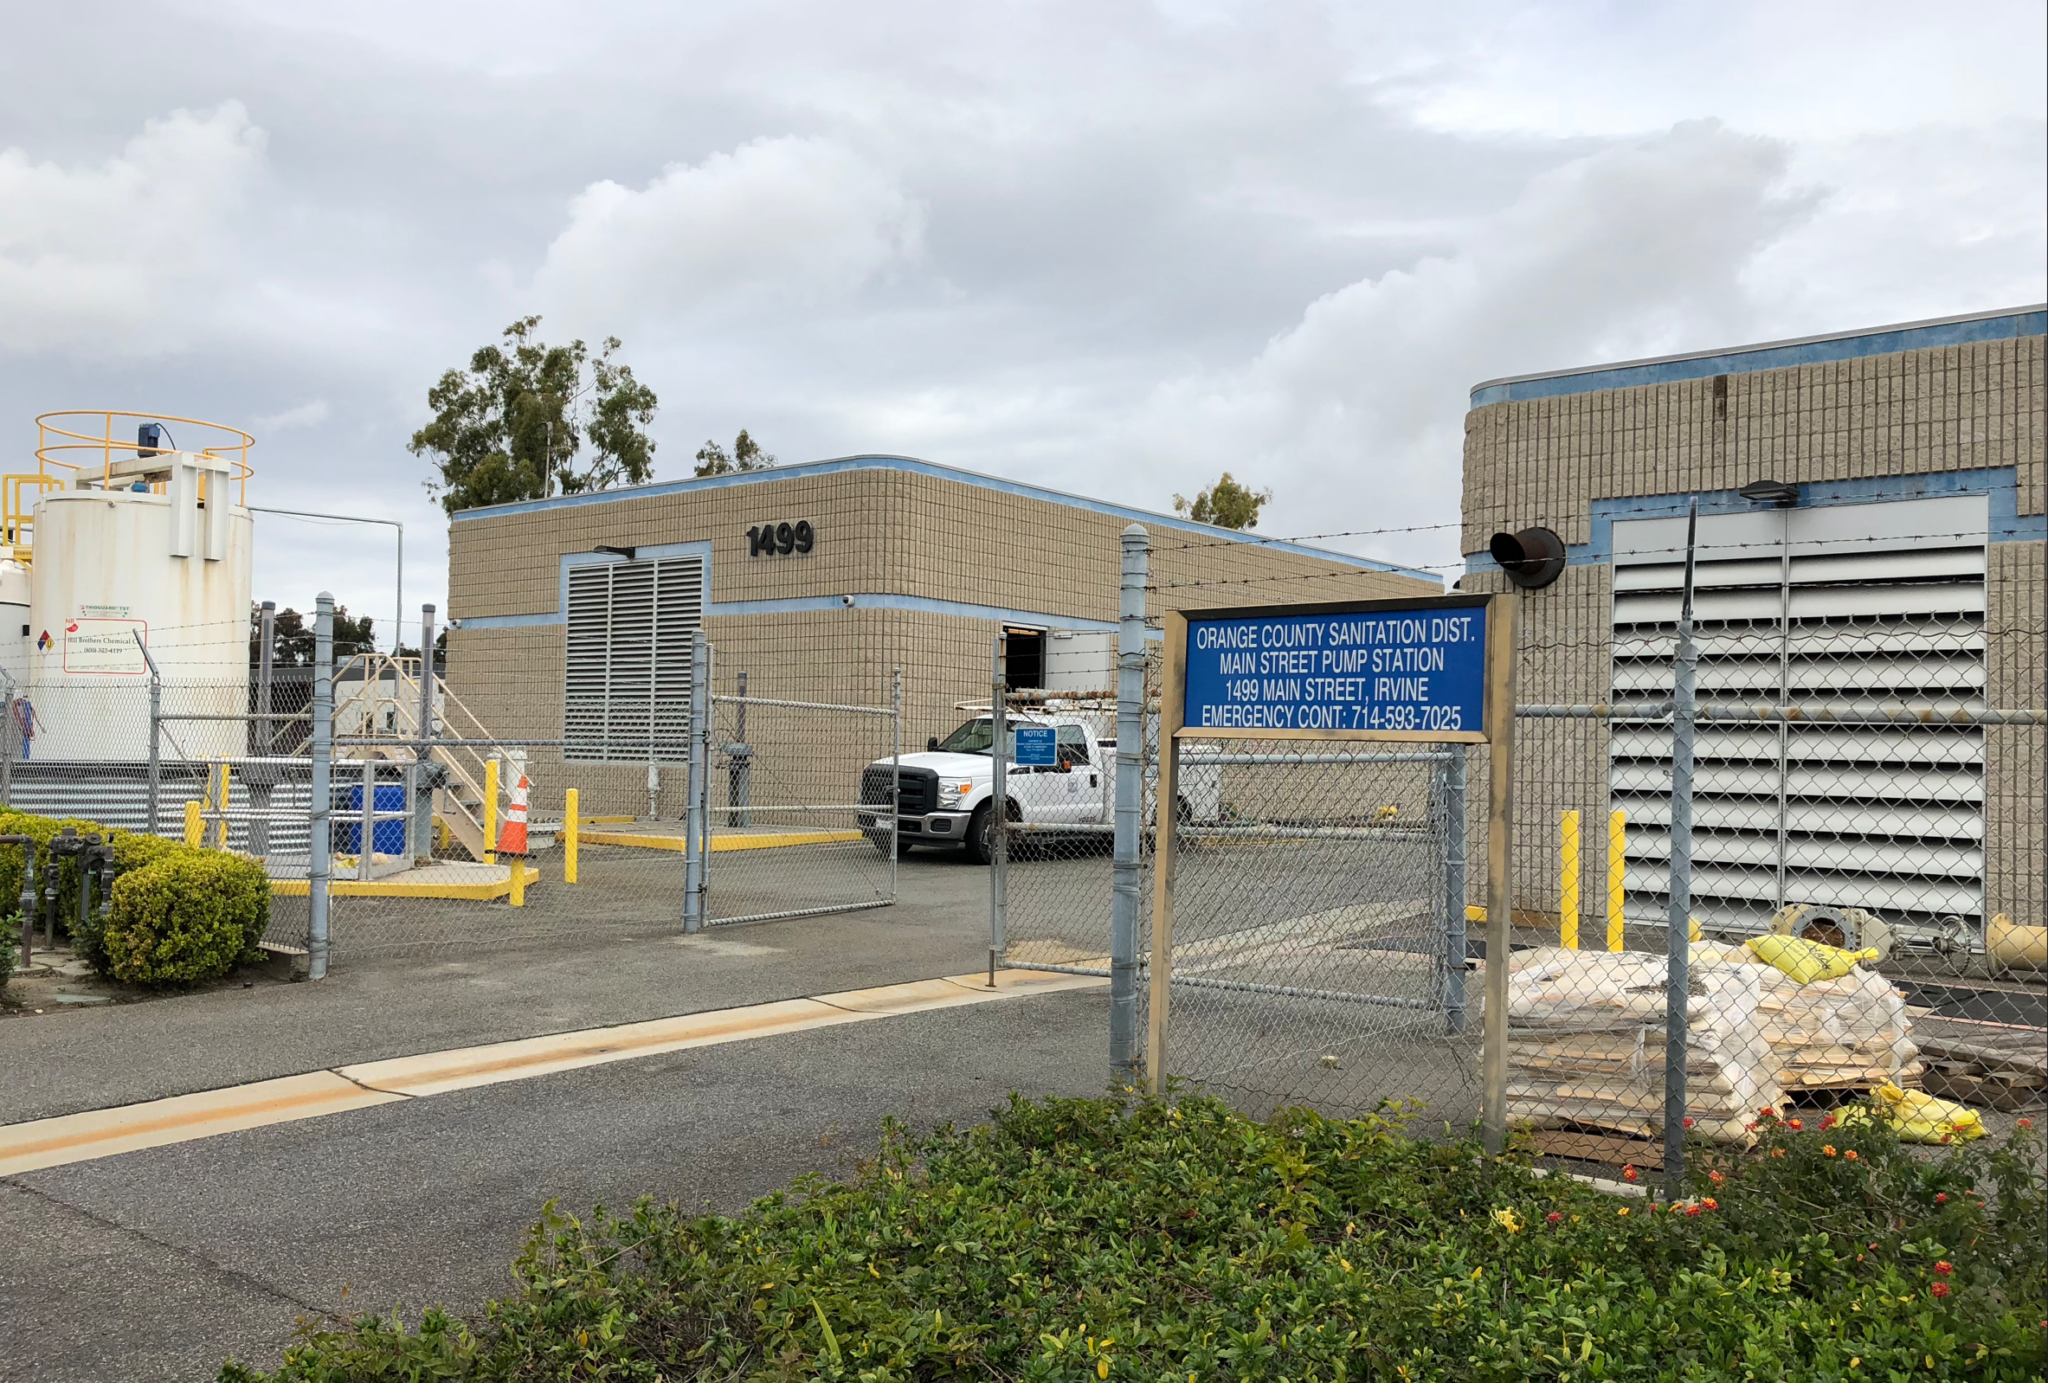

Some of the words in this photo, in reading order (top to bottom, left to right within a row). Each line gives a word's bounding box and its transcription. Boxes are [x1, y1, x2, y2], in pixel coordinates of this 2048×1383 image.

[746, 520, 814, 557] 1499
[1196, 626, 1258, 649] ORANGE
[1261, 623, 1325, 648] COUNTY
[1329, 618, 1426, 646] SANITATION
[1432, 617, 1475, 643] DIST.
[1219, 652, 1256, 675] MAIN
[1260, 650, 1318, 674] STREET
[1322, 649, 1368, 673] PUMP
[1372, 646, 1444, 673] STATION
[1226, 679, 1259, 702] 1499
[1263, 678, 1301, 701] MAIN
[1305, 677, 1369, 705] STREET,
[1374, 677, 1429, 701] IRVINE
[1202, 704, 1294, 728] EMERGENCY
[1298, 705, 1346, 729] CONT:
[1351, 705, 1461, 731] 714-593-7025
[1023, 730, 1048, 738] NOTICE
